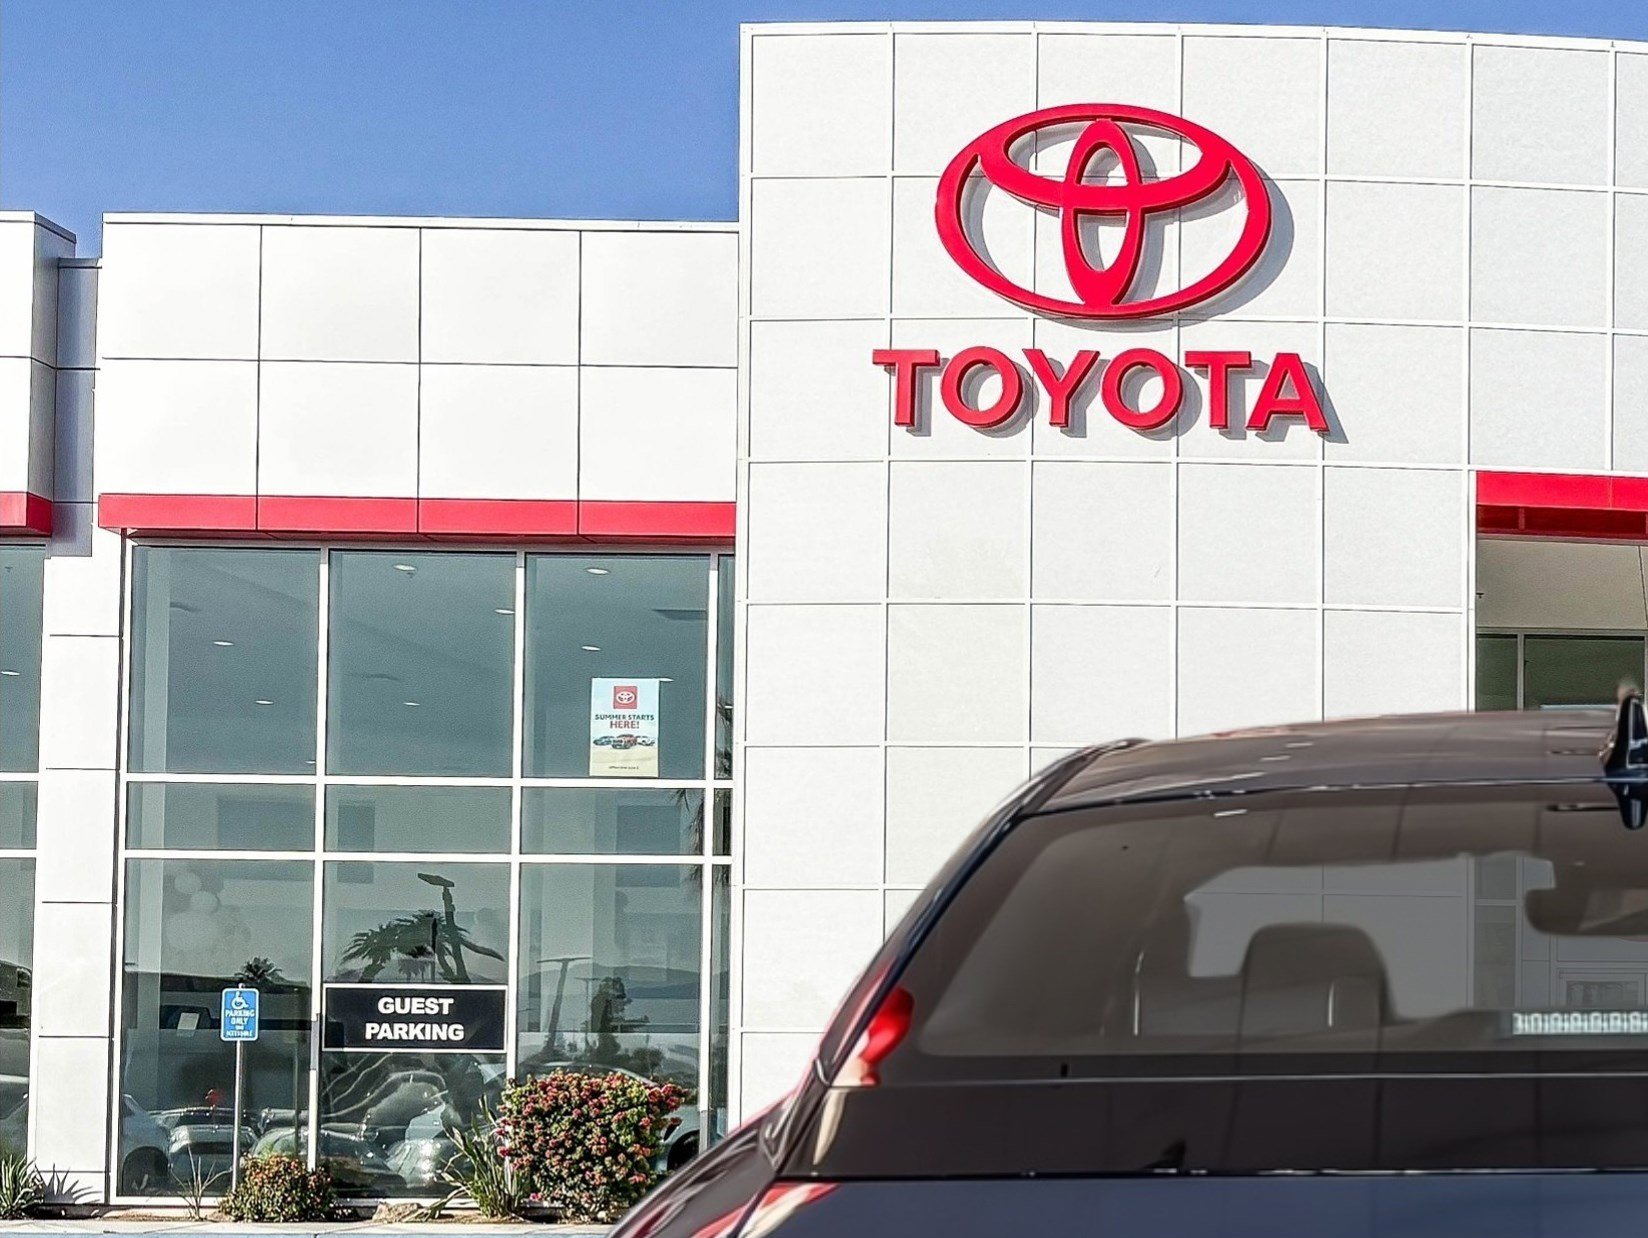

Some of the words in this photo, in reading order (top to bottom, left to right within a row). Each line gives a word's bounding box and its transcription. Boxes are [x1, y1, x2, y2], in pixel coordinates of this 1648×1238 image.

[872, 346, 1329, 433] TOYOTA
[609, 721, 640, 729] HERE!
[377, 997, 454, 1015] GUEST
[225, 1009, 255, 1018] PARKING
[230, 1017, 248, 1026] ONLY
[365, 1022, 464, 1041] PARKING
